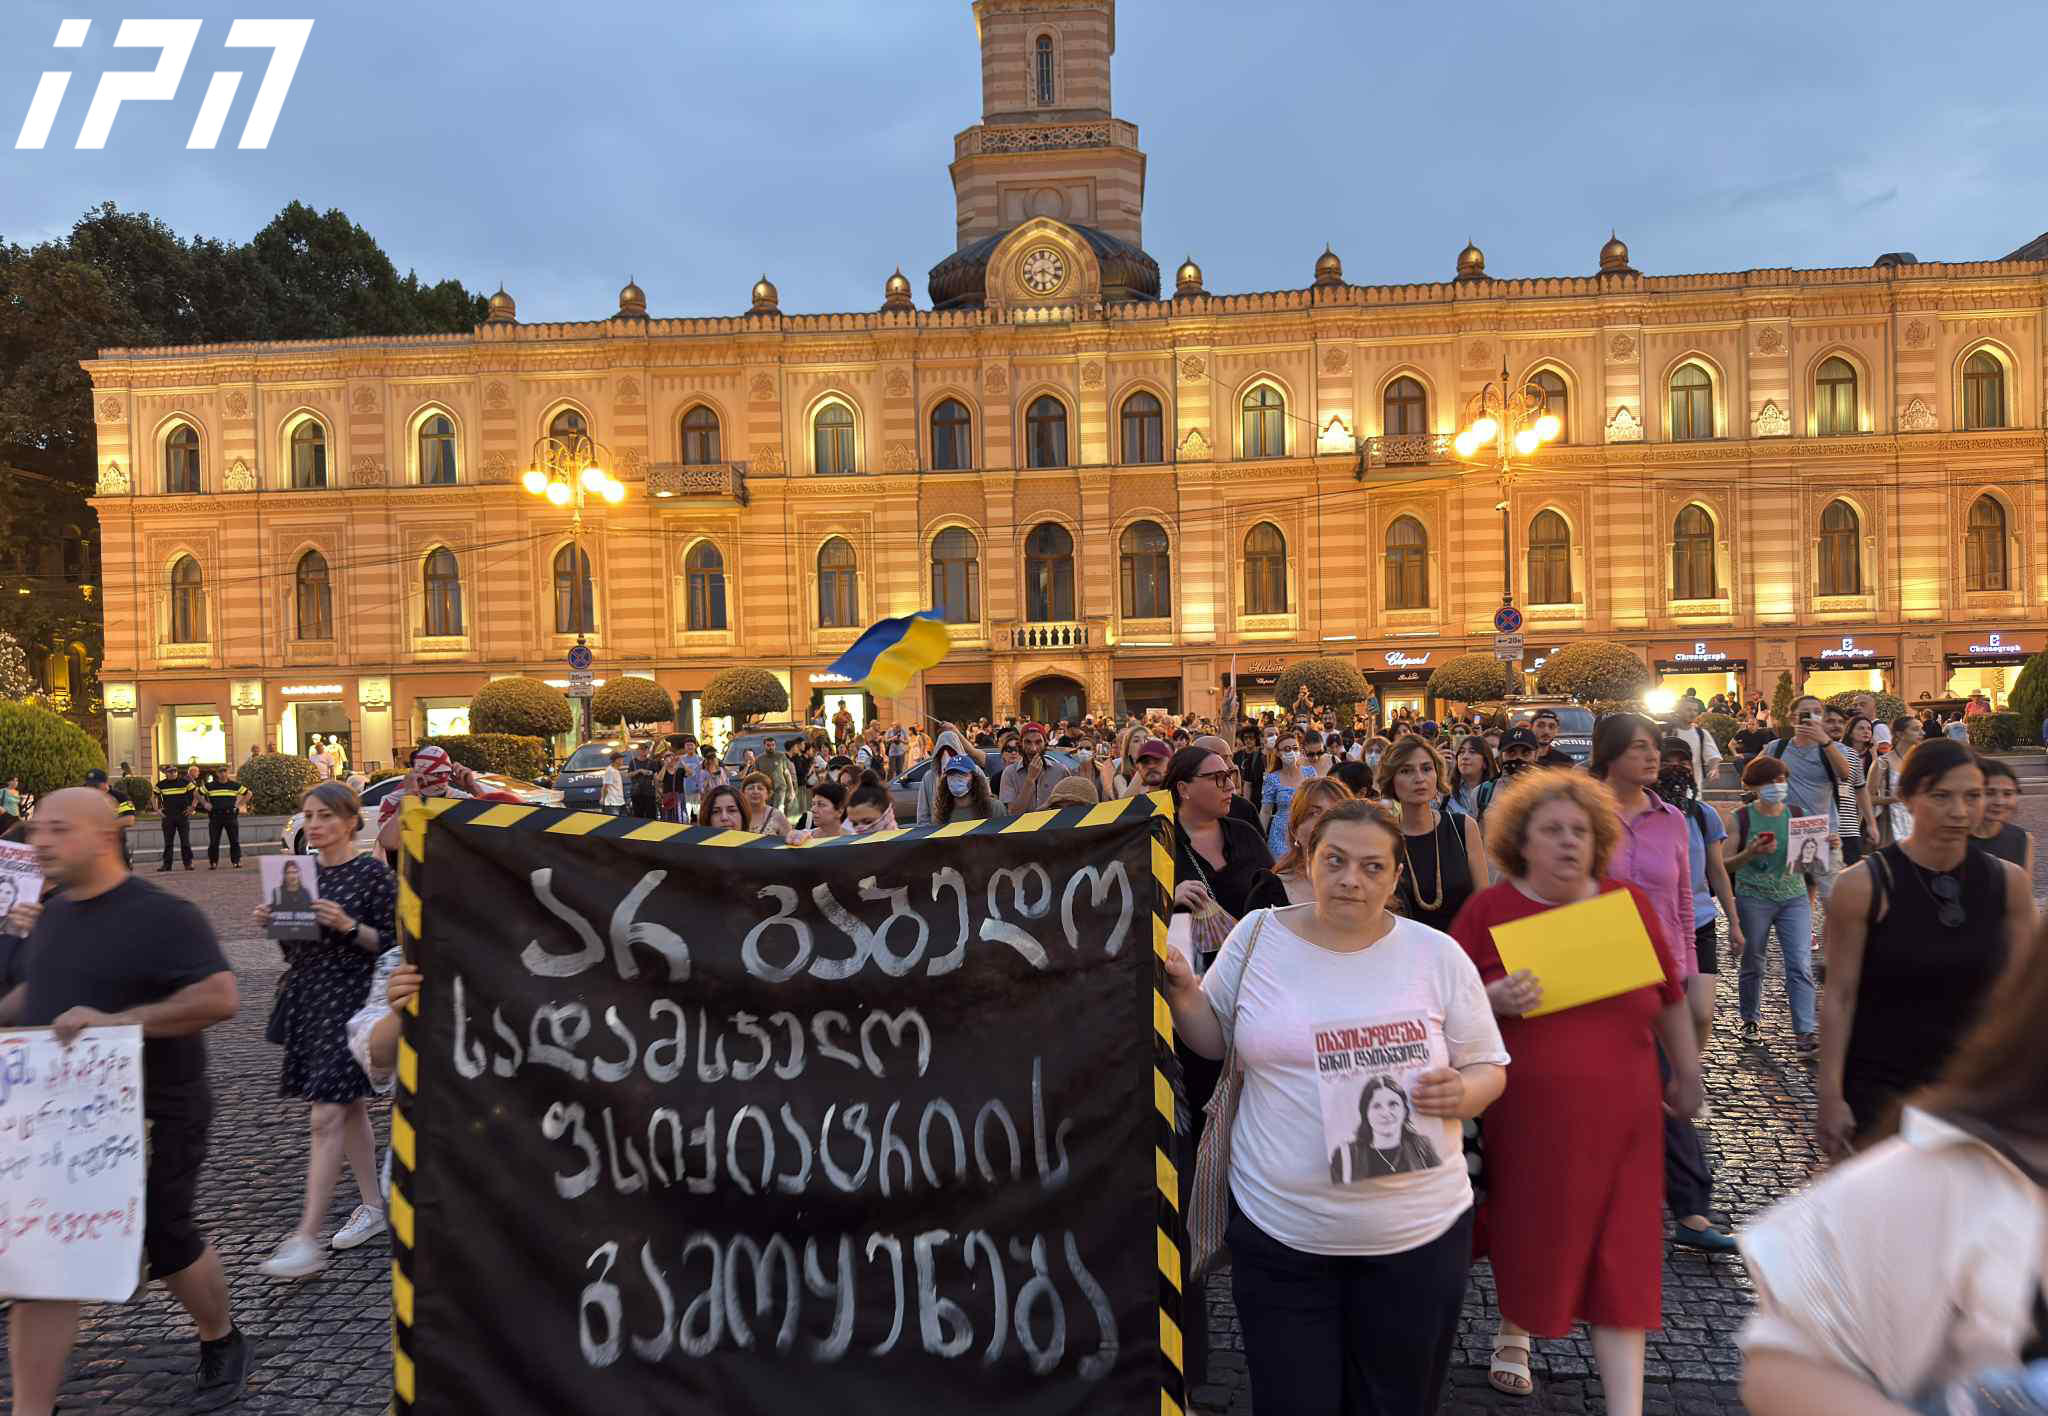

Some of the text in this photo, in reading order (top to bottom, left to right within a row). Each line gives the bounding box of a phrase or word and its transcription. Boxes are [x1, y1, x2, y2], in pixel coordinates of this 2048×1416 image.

[1384, 651, 1432, 669] Chopard
[520, 858, 1135, 983] არ გაბედო
[452, 975, 932, 1083] სადამსჯელო
[542, 1055, 1074, 1200] ფსიქიატრიის
[578, 1229, 1120, 1380] გამოყენება
